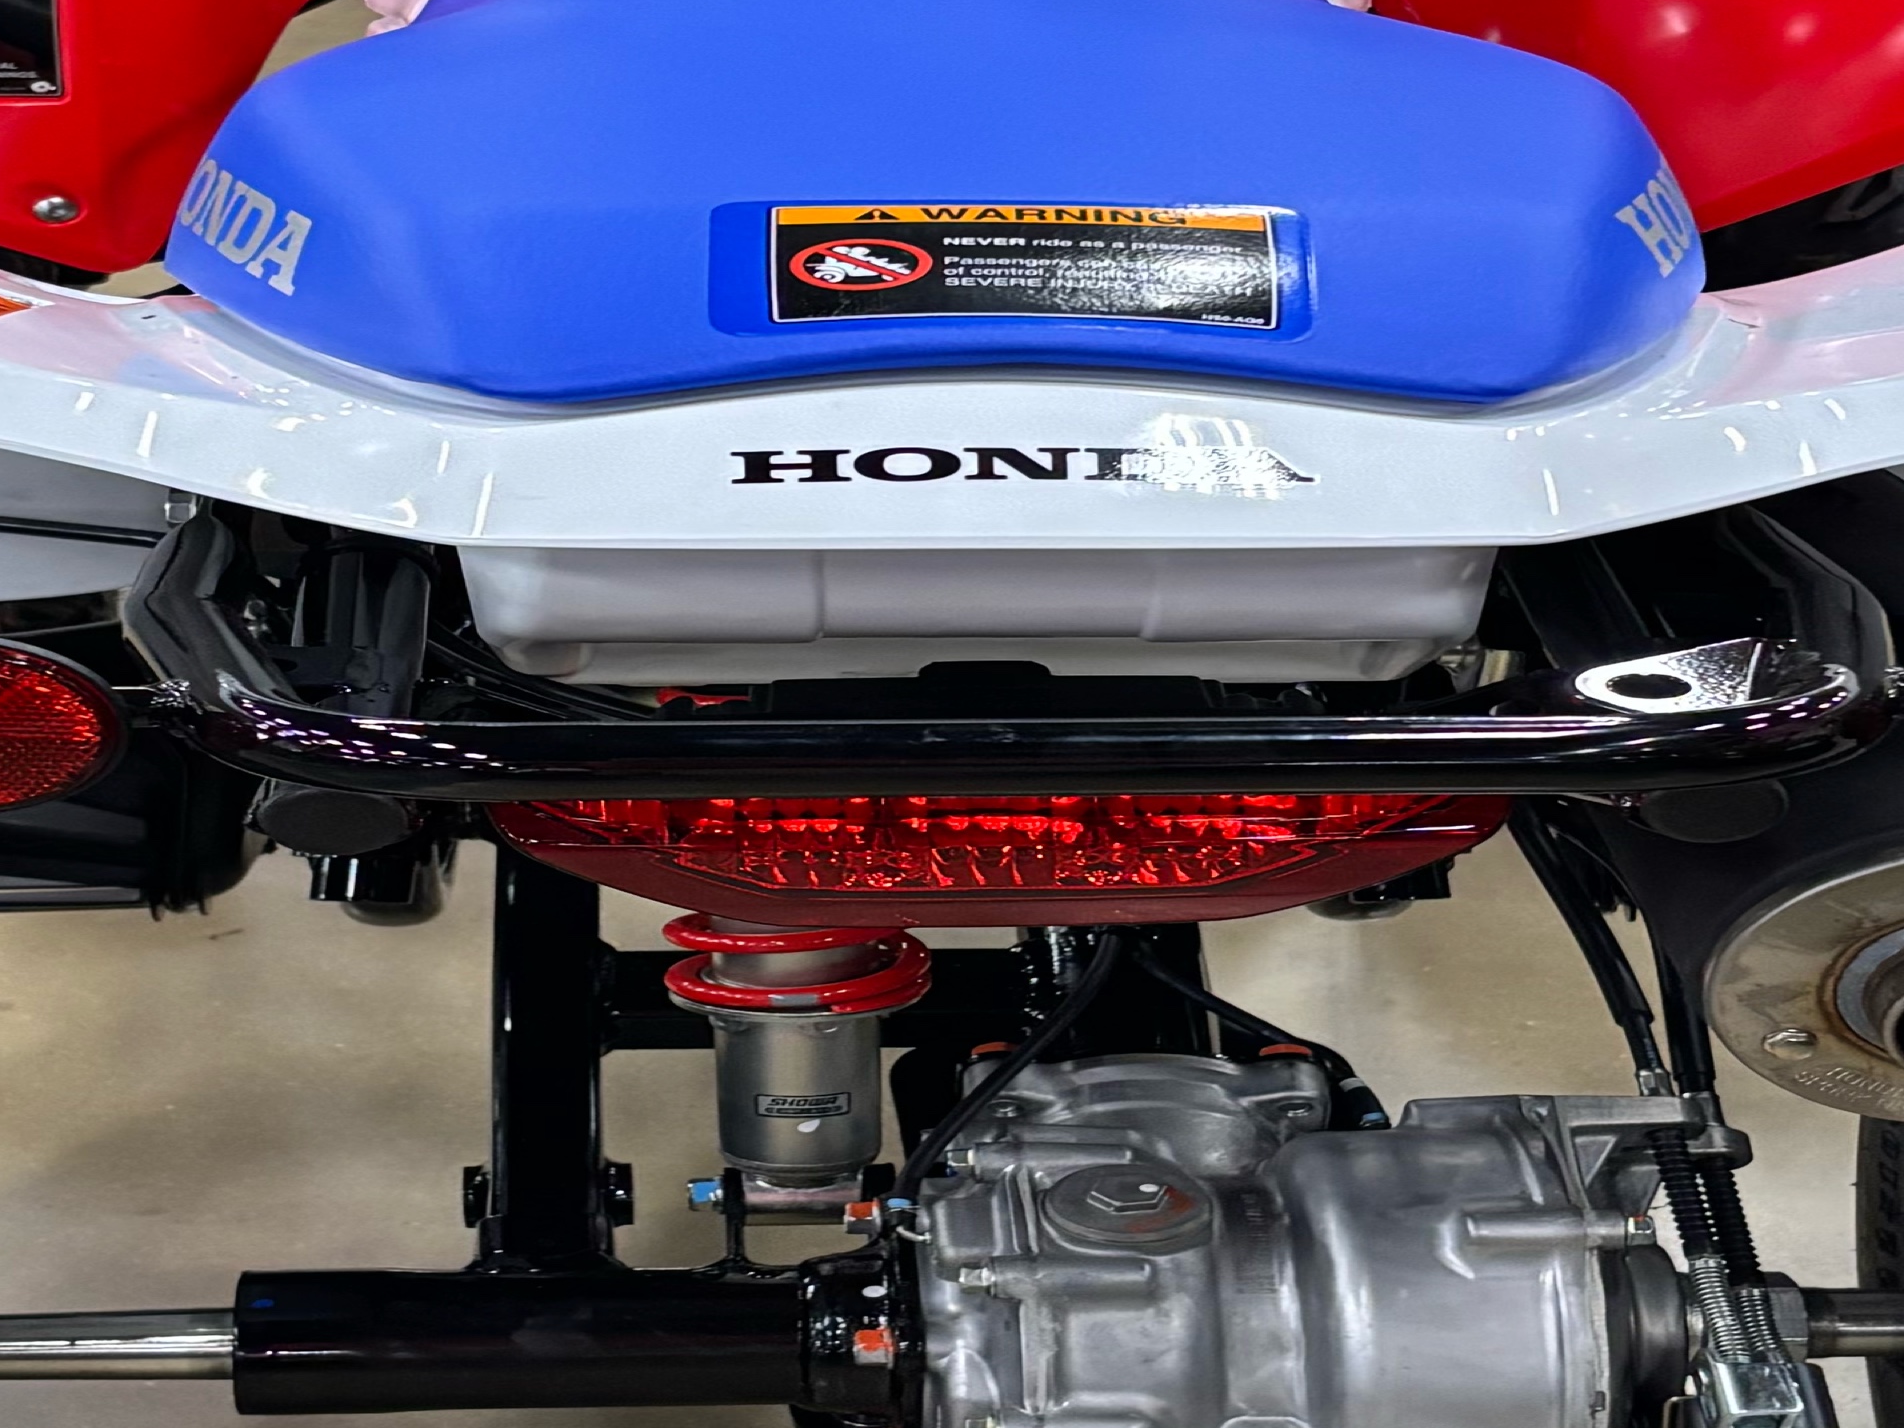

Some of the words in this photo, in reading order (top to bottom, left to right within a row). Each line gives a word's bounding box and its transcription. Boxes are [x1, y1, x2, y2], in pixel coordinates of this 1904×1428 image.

[919, 208, 1186, 225] WARNING
[180, 159, 312, 296] ONDA
[944, 237, 1026, 246] NEVER
[945, 278, 1043, 287] SEVERE
